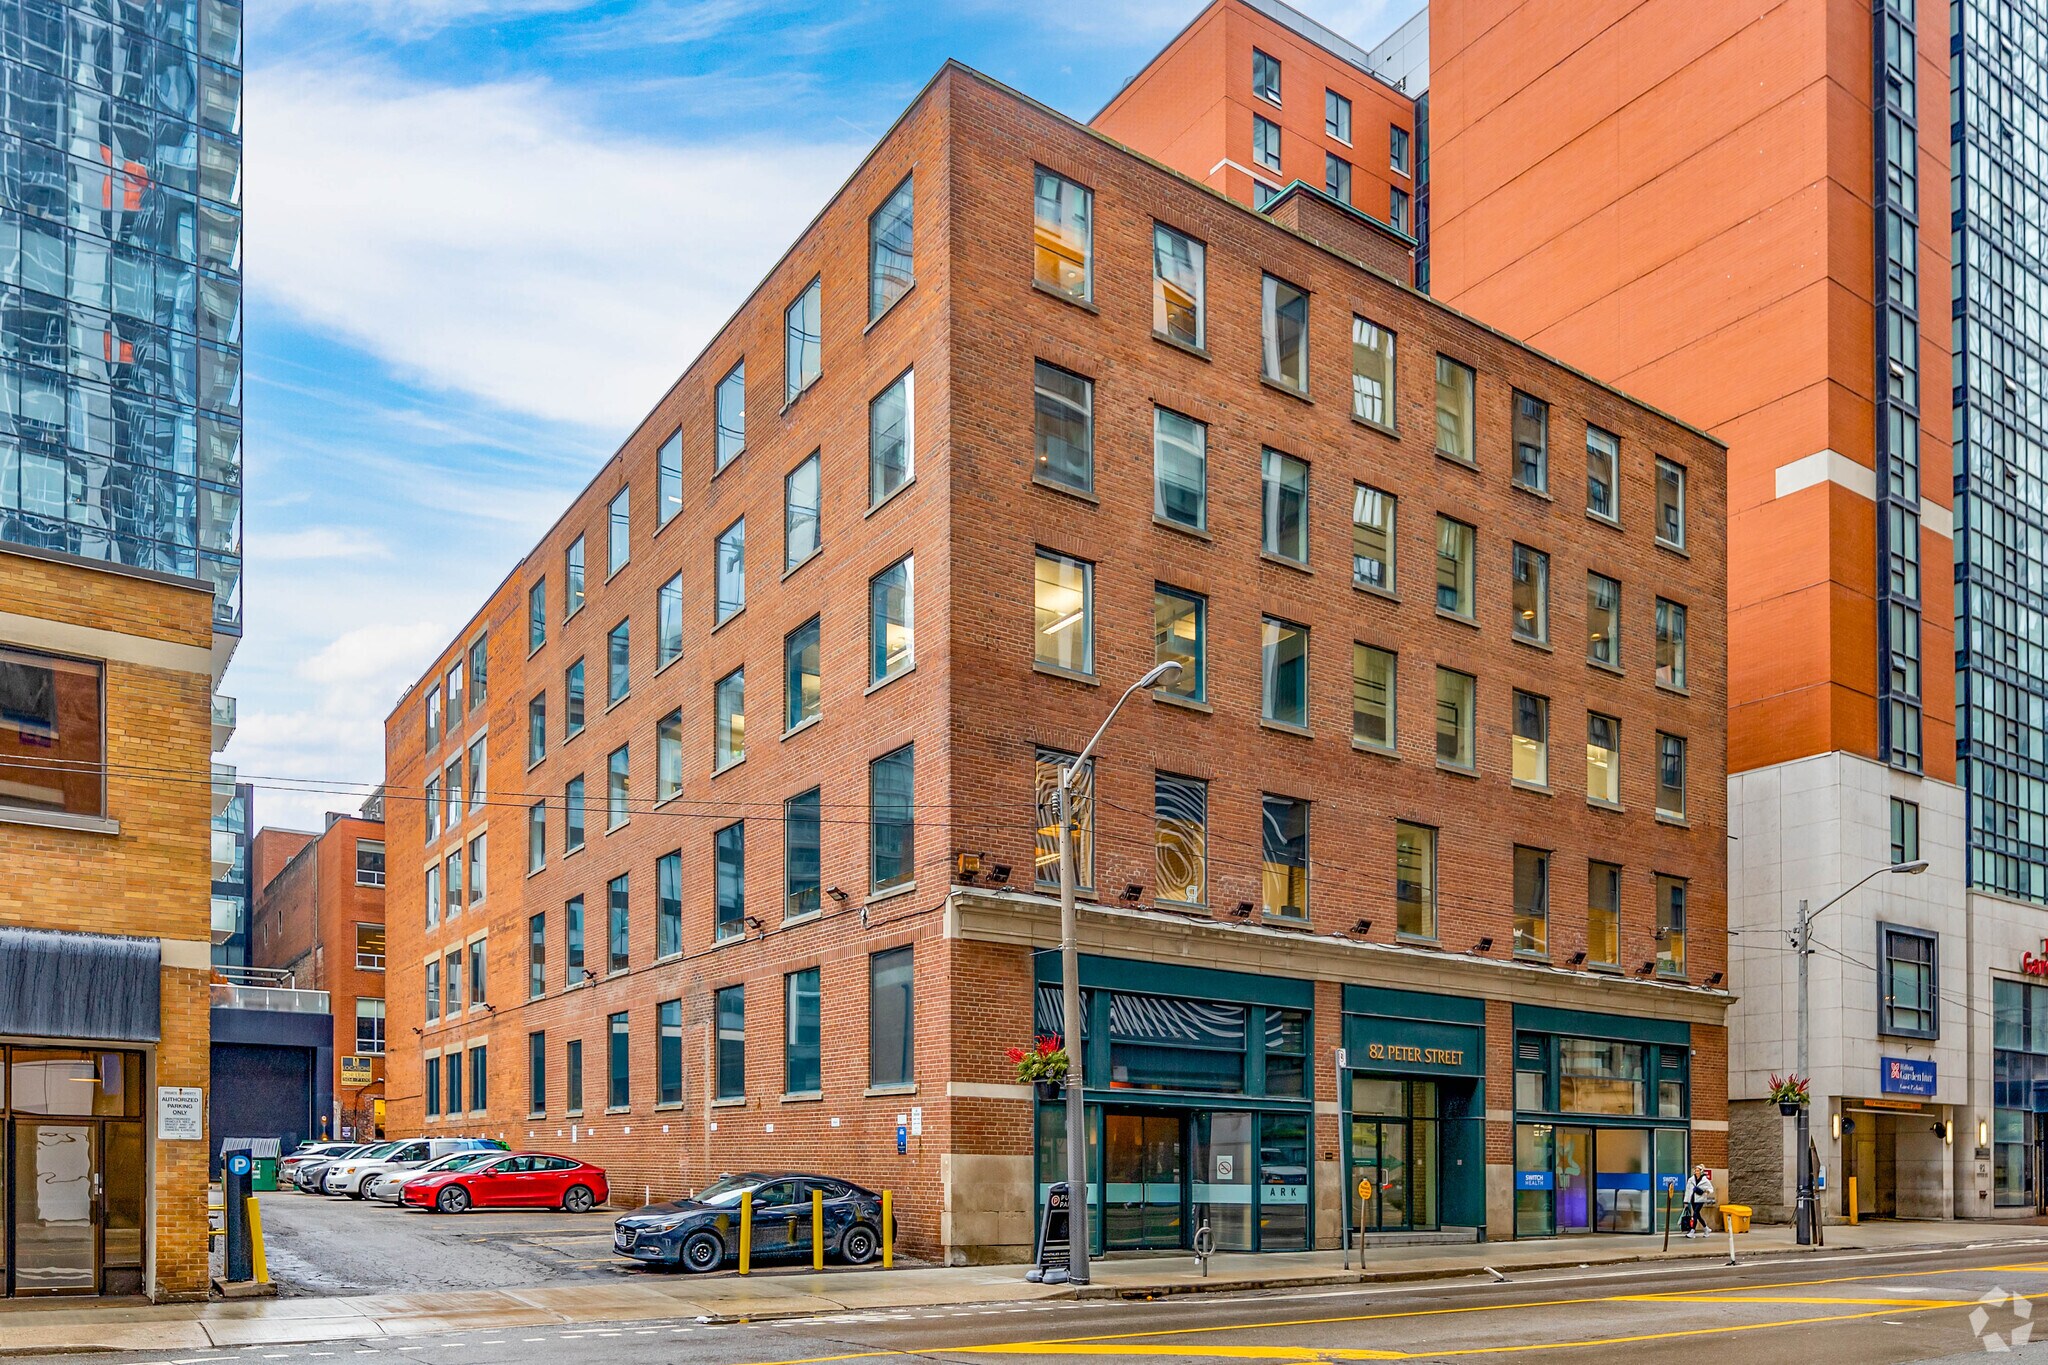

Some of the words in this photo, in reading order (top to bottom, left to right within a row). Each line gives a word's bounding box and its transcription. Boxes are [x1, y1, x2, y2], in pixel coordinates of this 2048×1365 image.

[1369, 1043, 1385, 1059] 82
[1387, 1045, 1422, 1062] PETER
[1424, 1048, 1464, 1065] STREET
[234, 1158, 247, 1172] P
[1269, 1187, 1297, 1197] ARK
